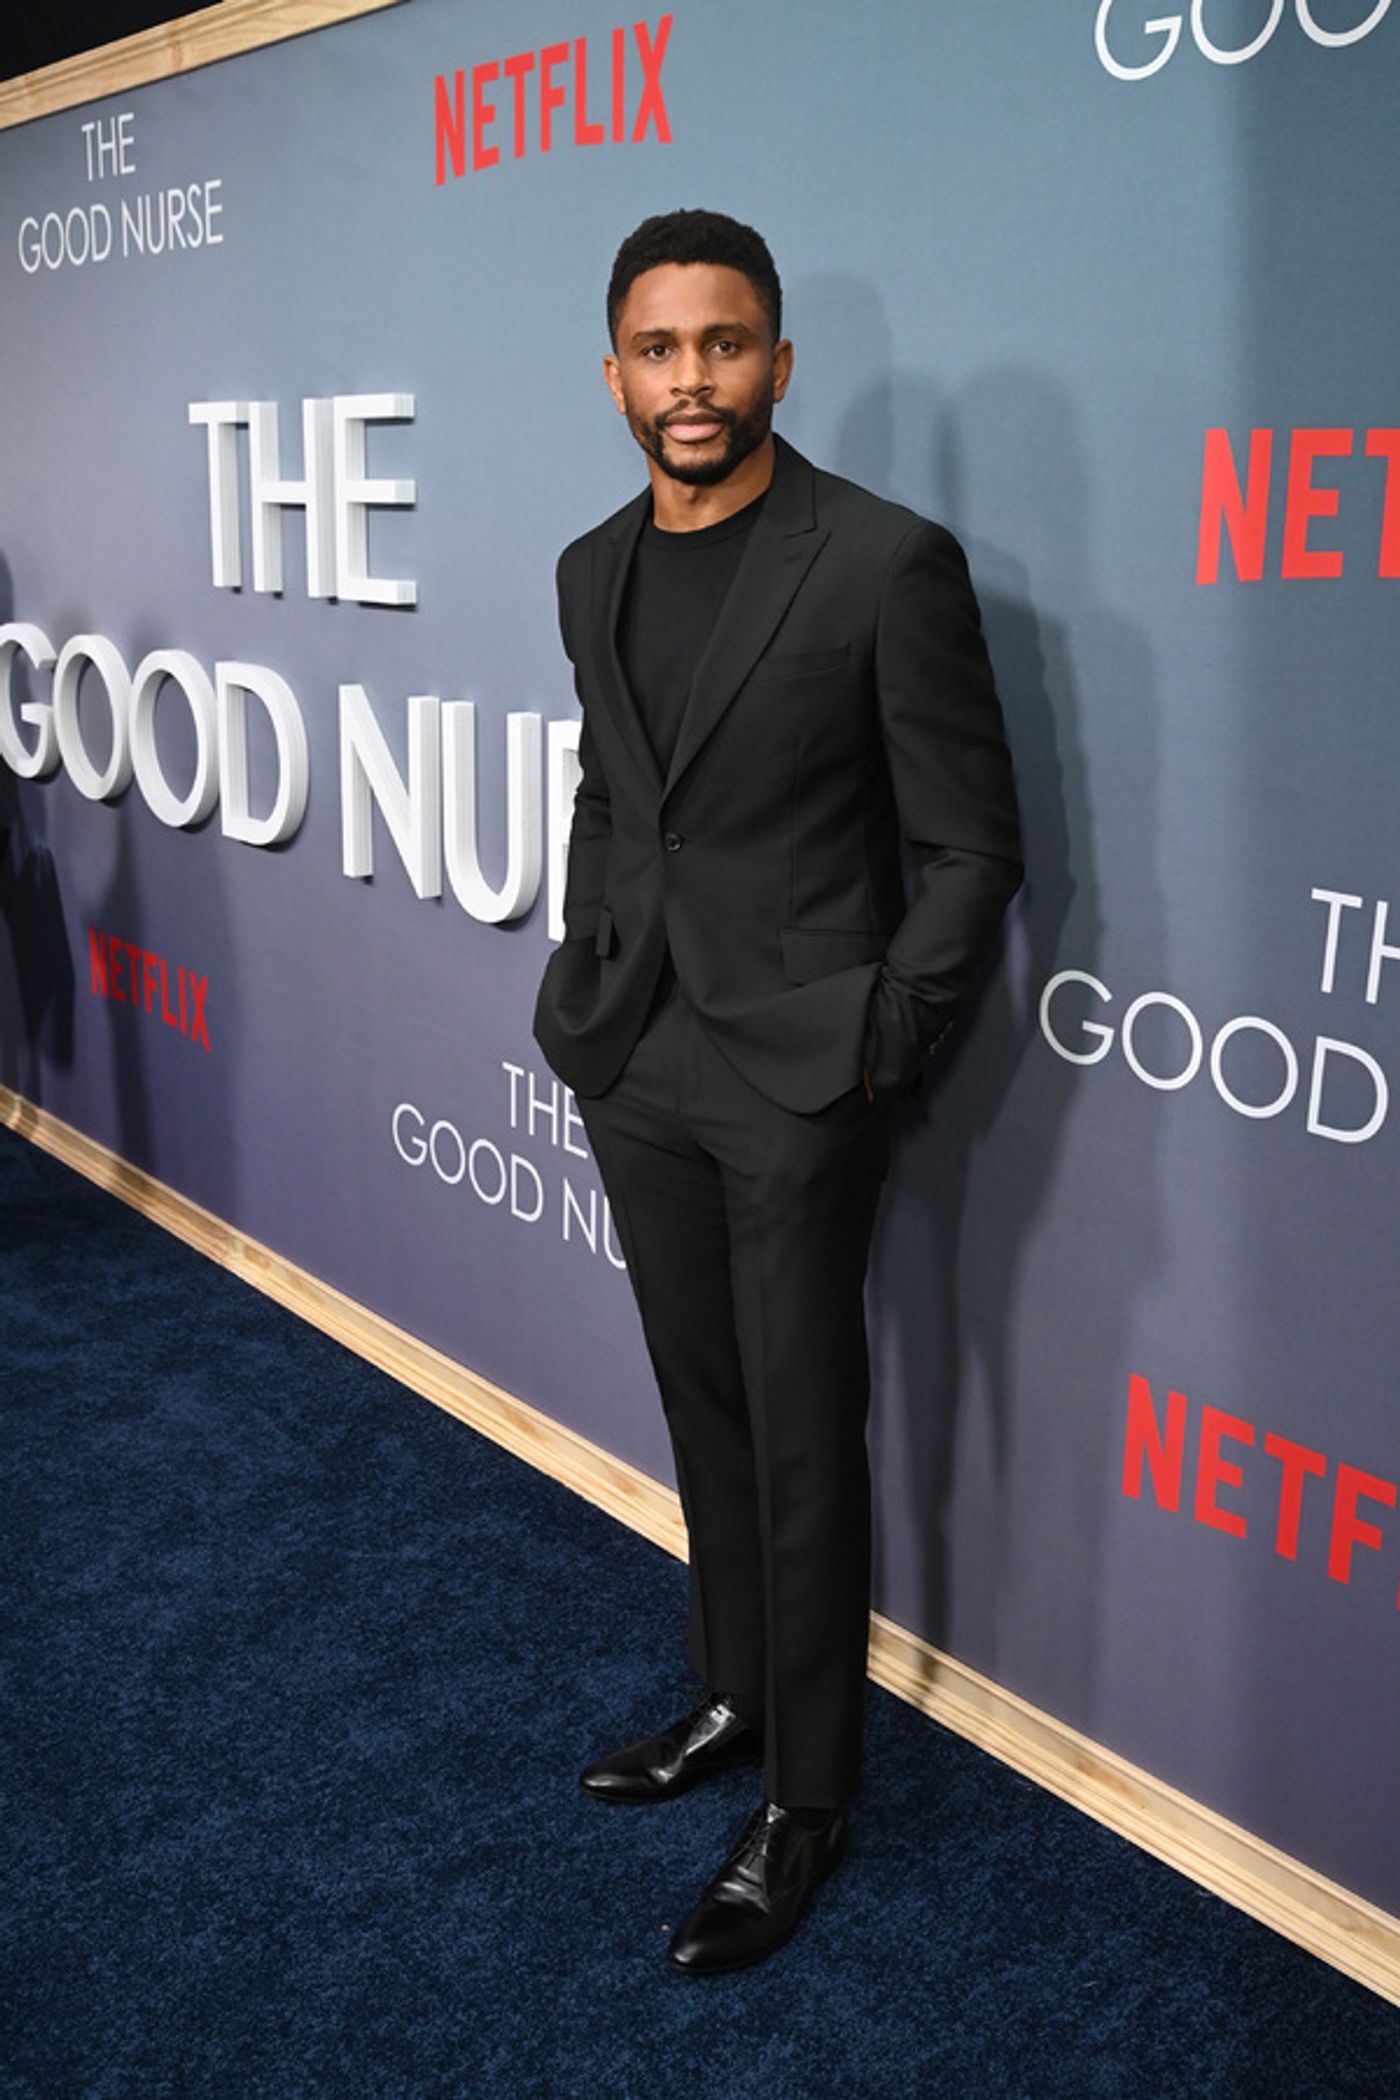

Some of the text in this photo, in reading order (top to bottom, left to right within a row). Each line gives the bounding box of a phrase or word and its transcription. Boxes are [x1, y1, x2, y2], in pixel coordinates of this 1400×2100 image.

[81, 112, 135, 182] THE
[434, 12, 674, 187] NETFLIX
[18, 178, 224, 274] GOOD NURSE
[188, 391, 417, 605] THE
[0, 622, 310, 845] GOOD
[88, 926, 212, 1053] NETFLIX
[1039, 969, 1389, 1144] GOOD
[391, 1102, 544, 1223] GOOD
[502, 1061, 589, 1159] THE
[1121, 1371, 1400, 1612] NETF
